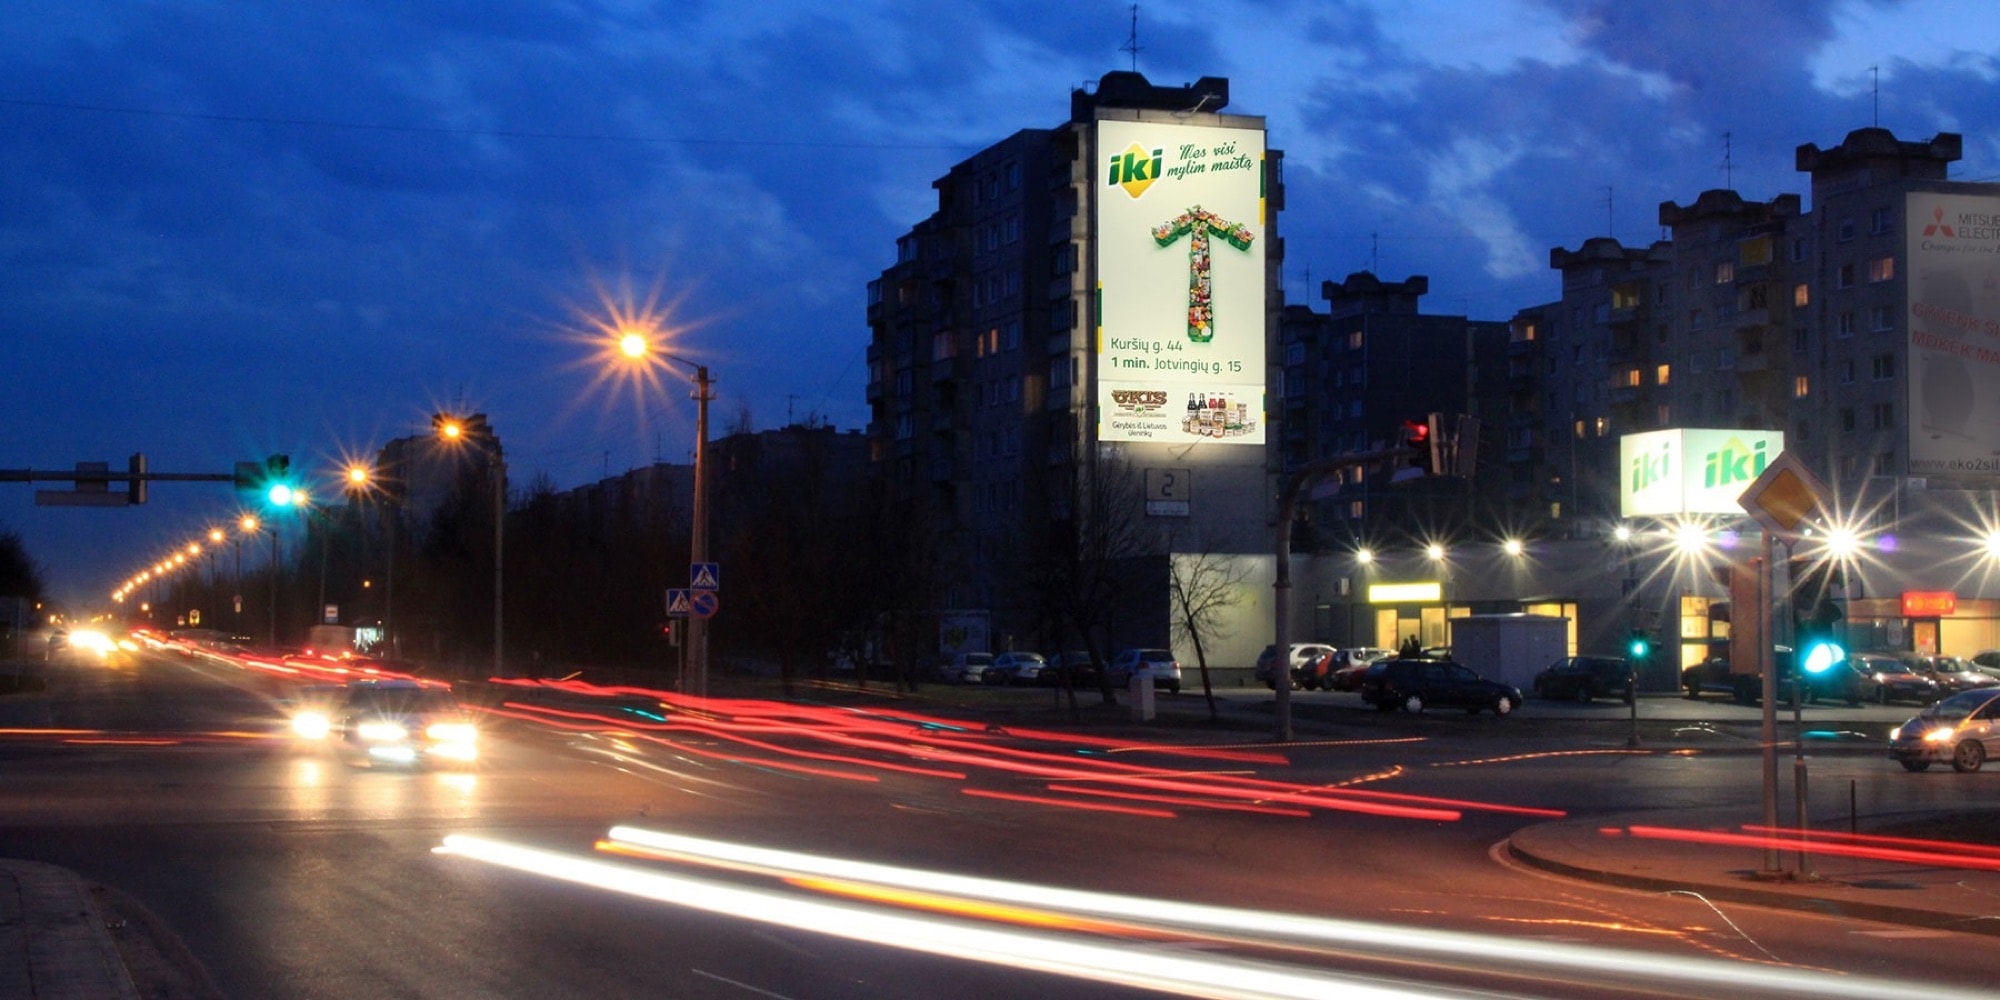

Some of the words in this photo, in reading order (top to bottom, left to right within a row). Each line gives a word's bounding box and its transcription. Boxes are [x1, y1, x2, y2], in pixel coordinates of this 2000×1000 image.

[1180, 143, 1206, 160] Mes
[1213, 141, 1236, 156] visi
[1108, 148, 1163, 186] iki
[1167, 160, 1206, 180] mylim
[1111, 337, 1149, 353] Kuršių
[1152, 341, 1163, 354] g.
[1167, 340, 1182, 352] 44
[1111, 357, 1118, 368] 1
[1123, 357, 1150, 369] min.
[1154, 358, 1209, 374] Jotvingių
[1212, 361, 1223, 375] g.
[1228, 361, 1242, 372] 15
[1633, 441, 1669, 493] iki
[1705, 440, 1766, 488] iki
[1162, 473, 1174, 497] 2
